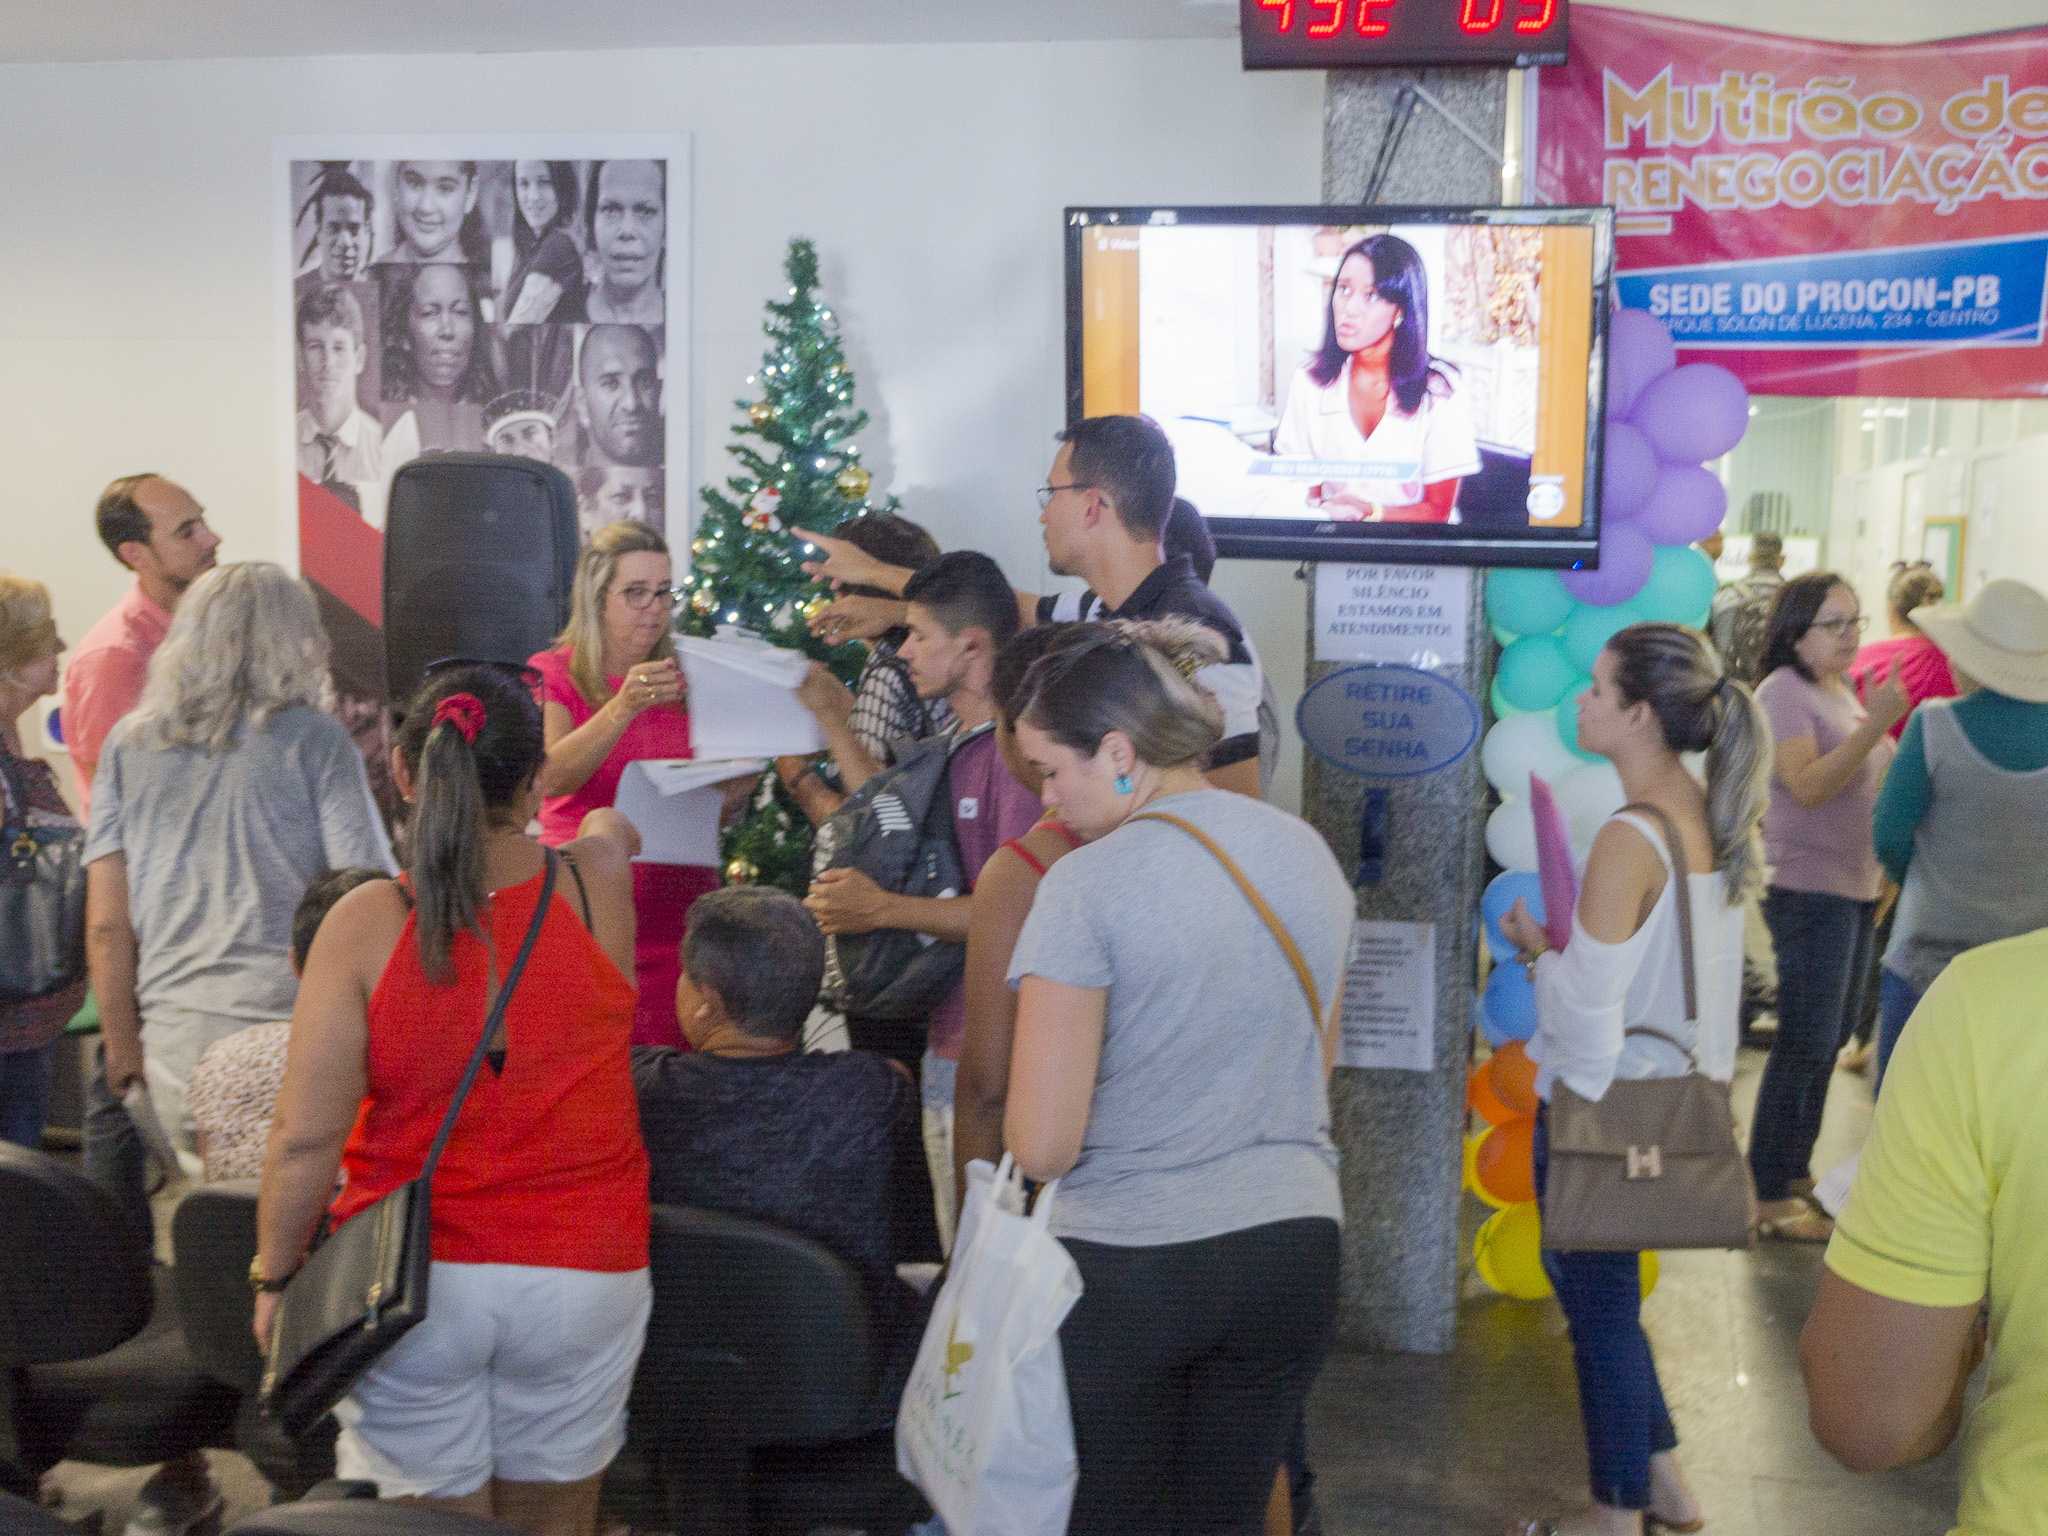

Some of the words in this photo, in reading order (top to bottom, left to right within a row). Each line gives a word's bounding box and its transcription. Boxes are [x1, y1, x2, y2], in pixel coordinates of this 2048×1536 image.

[1603, 62, 1923, 149] Mutirão
[1940, 74, 2048, 139] de
[1603, 133, 2048, 216] RENEGOCIAÇÃO
[1649, 282, 1733, 317] SEDE
[1740, 281, 1788, 316] DO
[1796, 273, 2001, 314] PROCON-PB
[1925, 307, 2001, 328] CENTRO
[1345, 567, 1379, 580] POR
[1382, 567, 1436, 581] FAVOR
[1351, 583, 1429, 600] SILÊNCIO
[1337, 603, 1414, 619] ESTAMOS
[1416, 604, 1443, 620] EM
[1345, 681, 1433, 705] RETIRE
[1361, 710, 1414, 730] SUA
[1344, 736, 1430, 761] SENHA
